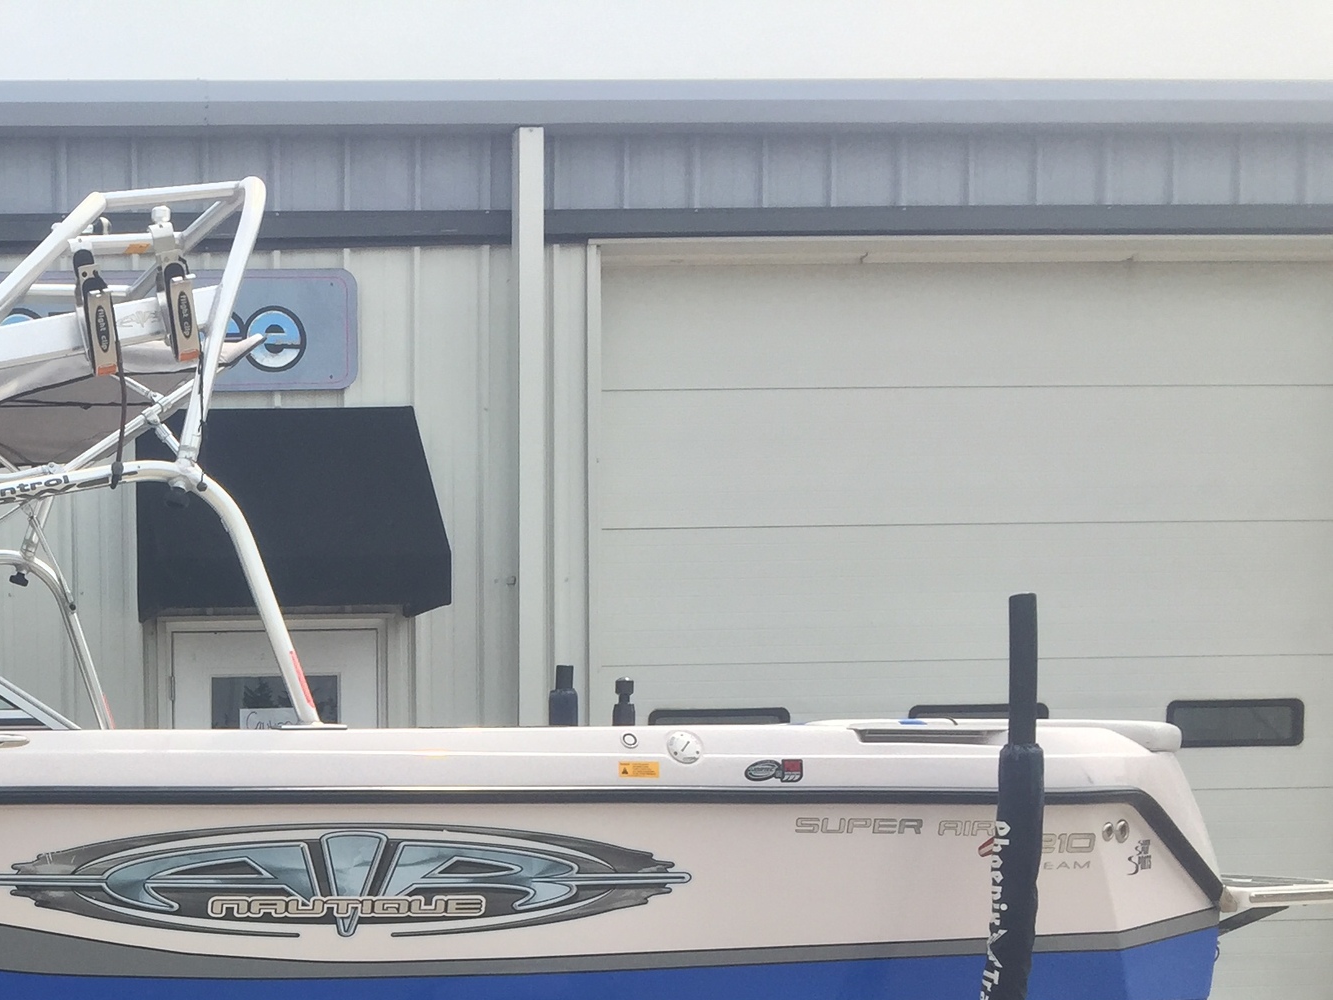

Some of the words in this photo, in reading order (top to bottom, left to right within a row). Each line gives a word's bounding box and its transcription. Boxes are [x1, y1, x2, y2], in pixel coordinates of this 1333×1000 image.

[795, 817, 923, 835] SUPER
[938, 820, 996, 836] AIR
[1043, 861, 1091, 870] EAM
[209, 895, 485, 916] NAUTIQUE
